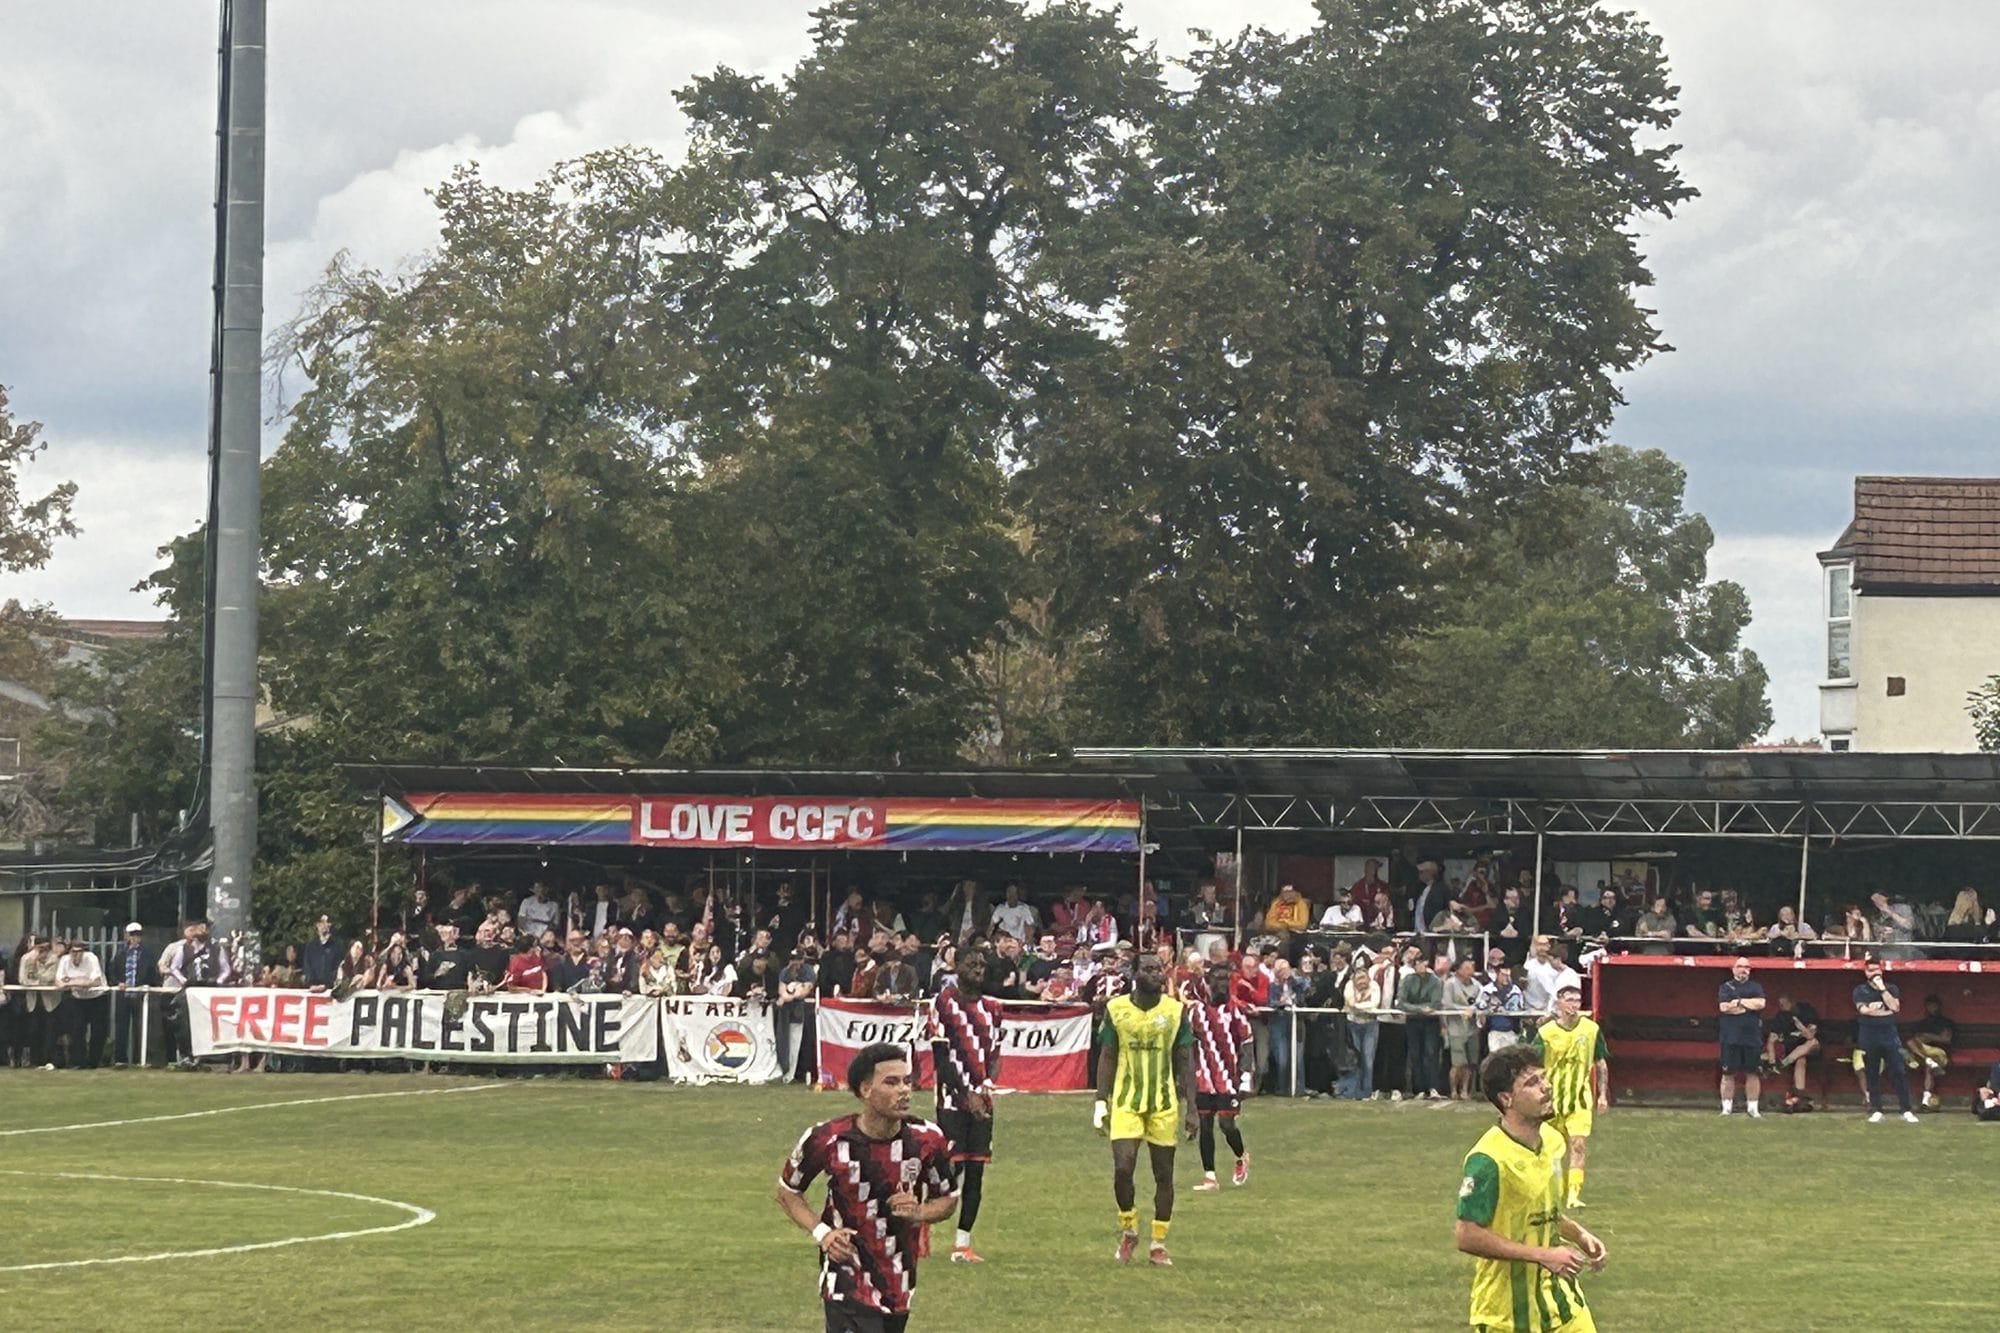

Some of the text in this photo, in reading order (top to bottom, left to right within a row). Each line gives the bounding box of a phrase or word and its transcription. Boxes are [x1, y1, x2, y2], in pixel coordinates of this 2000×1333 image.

[640, 802, 874, 842] LOVE CCFC
[210, 995, 622, 1053] FREE PALESTINE
[665, 999, 693, 1015] WE
[705, 1001, 748, 1017] ARE
